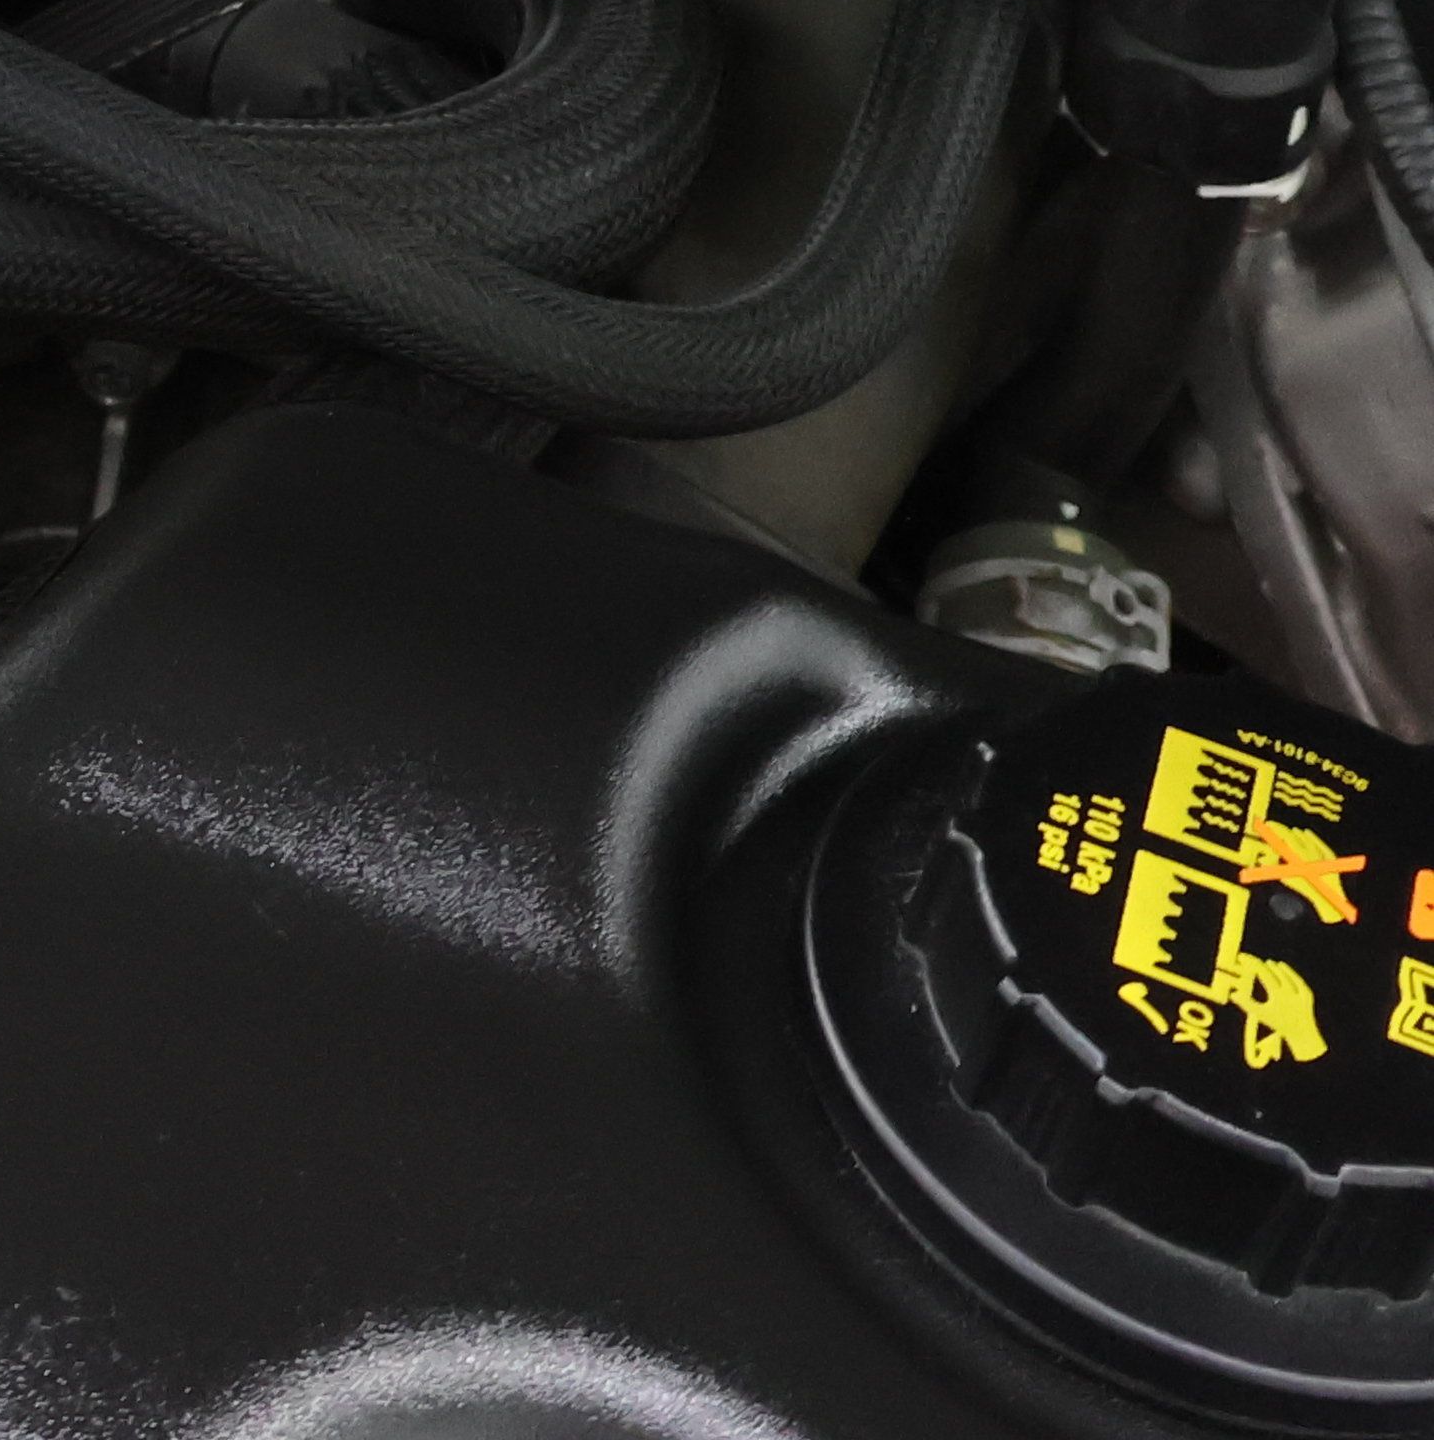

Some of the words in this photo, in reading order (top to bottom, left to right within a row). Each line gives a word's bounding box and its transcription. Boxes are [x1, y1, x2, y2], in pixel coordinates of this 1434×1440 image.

[1048, 792, 1082, 827] 16
[1083, 793, 1126, 843] 110
[1036, 820, 1071, 875] psi
[1070, 840, 1117, 896] kPa
[1171, 999, 1216, 1053] OK
